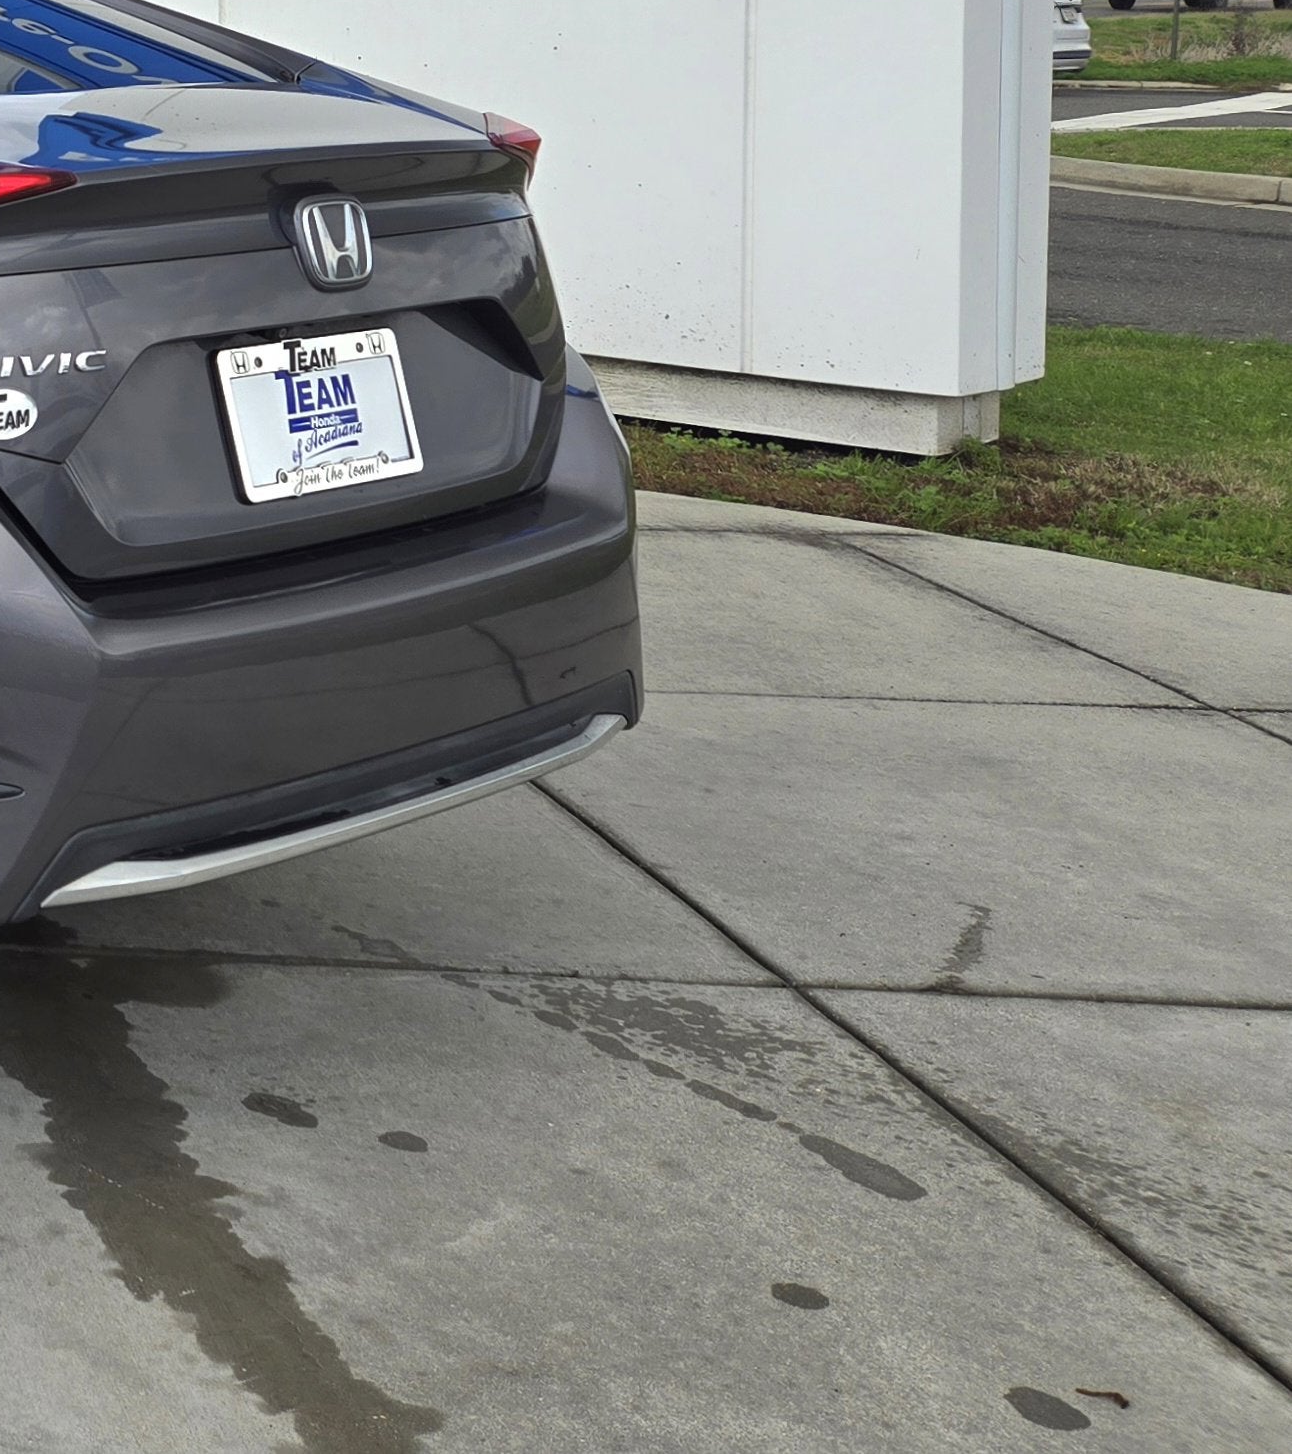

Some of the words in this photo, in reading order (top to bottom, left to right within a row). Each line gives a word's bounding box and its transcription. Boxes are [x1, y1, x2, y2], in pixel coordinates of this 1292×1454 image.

[283, 341, 336, 373] TEAM
[274, 370, 356, 415] TEAM
[310, 413, 342, 428] Honda
[305, 422, 362, 453] Acadiana
[294, 468, 321, 495] Join
